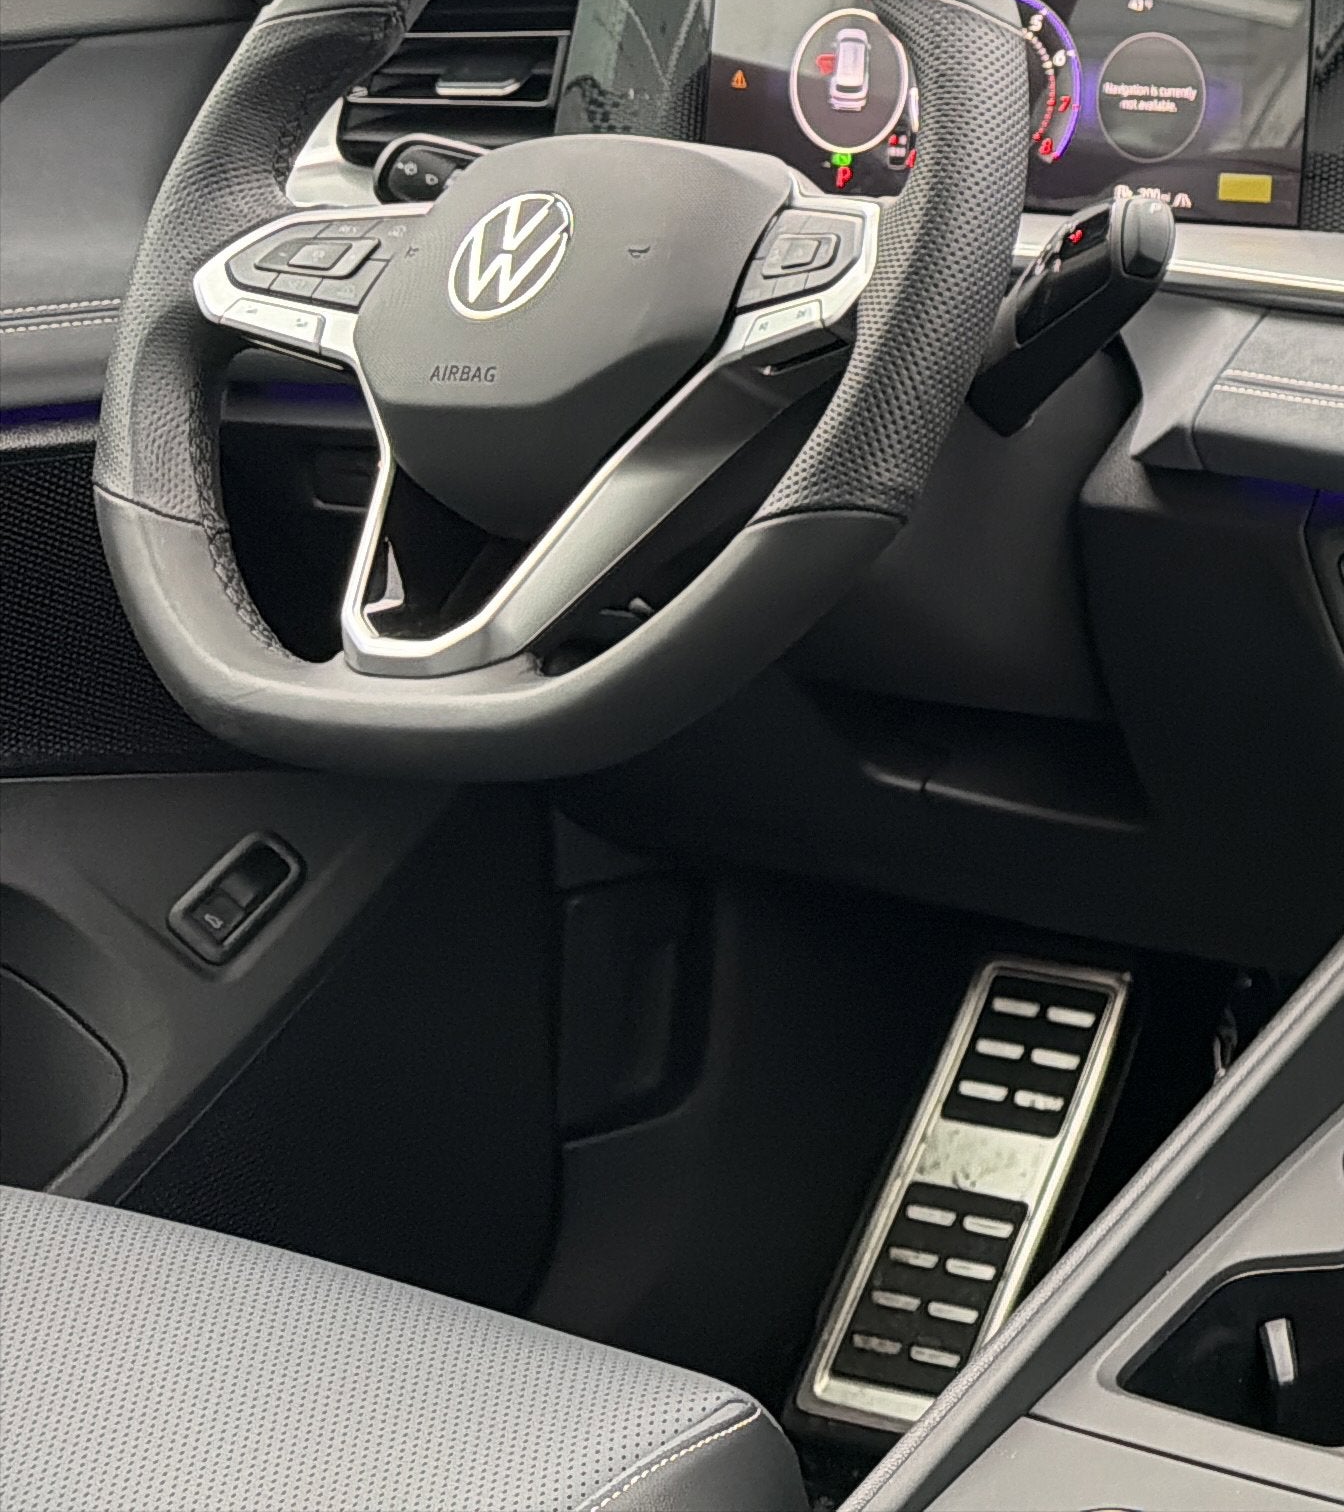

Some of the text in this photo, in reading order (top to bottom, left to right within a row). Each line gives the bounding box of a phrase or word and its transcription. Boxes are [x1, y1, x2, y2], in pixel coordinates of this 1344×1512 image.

[1053, 49, 1066, 67] 6
[1039, 138, 1053, 155] 8
[836, 167, 853, 189] P
[429, 364, 497, 384] AIRBAG
